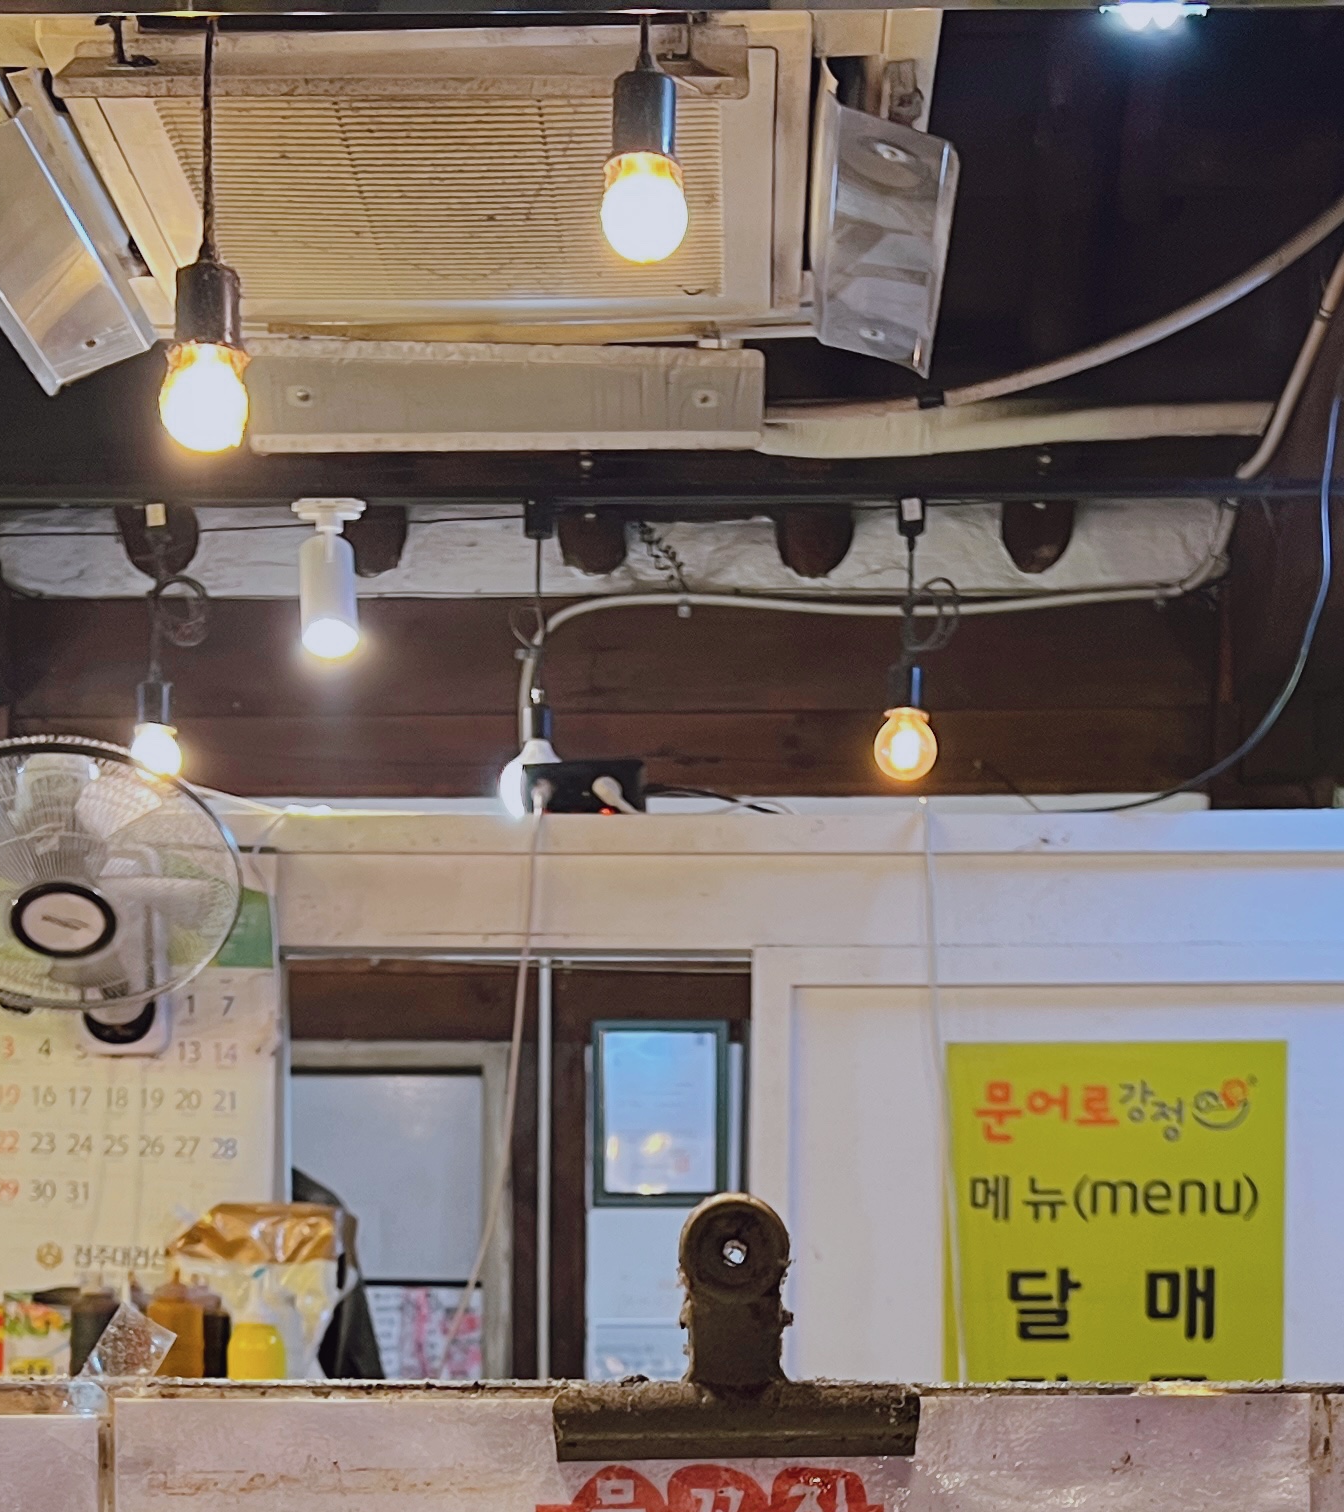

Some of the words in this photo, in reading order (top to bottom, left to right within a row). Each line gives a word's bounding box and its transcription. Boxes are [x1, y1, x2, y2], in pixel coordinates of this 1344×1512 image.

[29, 1131, 56, 1155] 23
[66, 1132, 94, 1157] 24
[102, 1134, 129, 1157] 25
[138, 1135, 165, 1159] 26
[174, 1135, 201, 1159] 27
[211, 1136, 239, 1161] 28
[29, 1179, 57, 1203] 30
[66, 1179, 90, 1203] 31
[969, 1173, 1260, 1223] 메뉴(menu)
